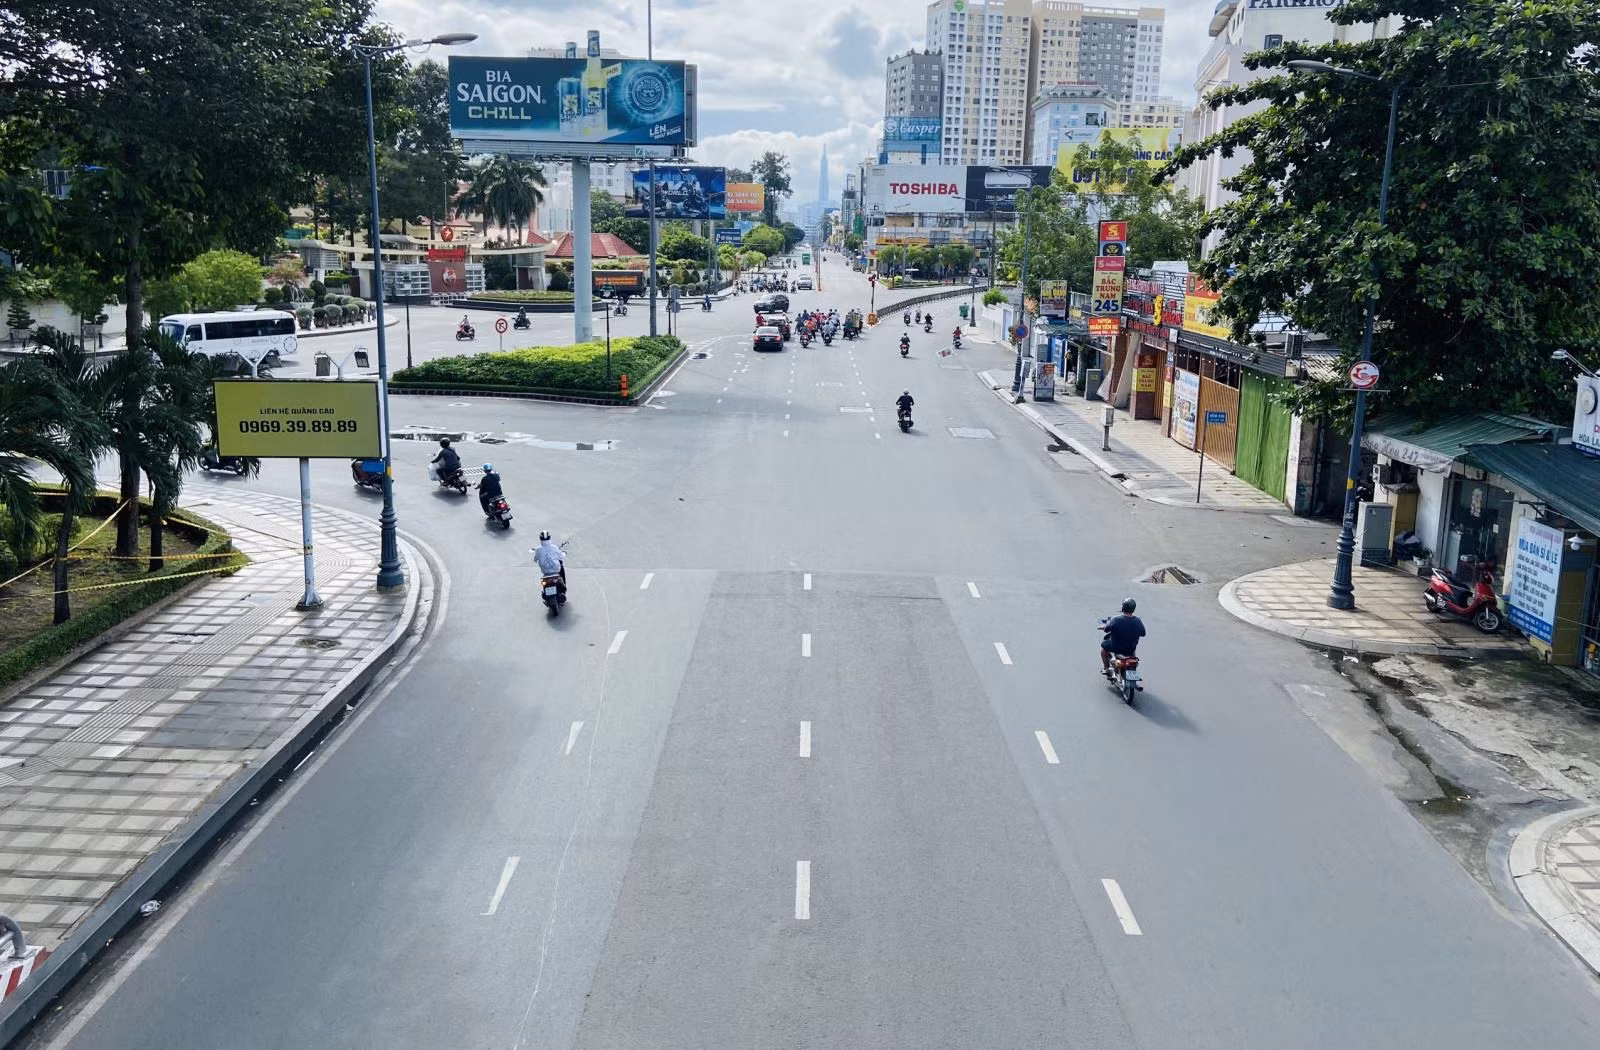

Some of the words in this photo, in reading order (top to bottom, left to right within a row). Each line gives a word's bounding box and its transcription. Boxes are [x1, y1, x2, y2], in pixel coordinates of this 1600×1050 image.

[486, 70, 512, 82] BIA
[457, 82, 542, 104] SAIGON
[468, 105, 532, 120] CHILL
[649, 124, 667, 137] LÊN
[900, 120, 941, 135] Casper
[889, 183, 959, 195] TOSHIBA
[1094, 300, 1119, 311] 245
[260, 406, 277, 415] LIÊN
[279, 407, 290, 416] HỆ
[291, 406, 317, 415] QUẢNG
[319, 407, 335, 415] CÁO
[239, 420, 357, 433] 0969.39.89.89
[1529, 541, 1540, 557] BÁN
